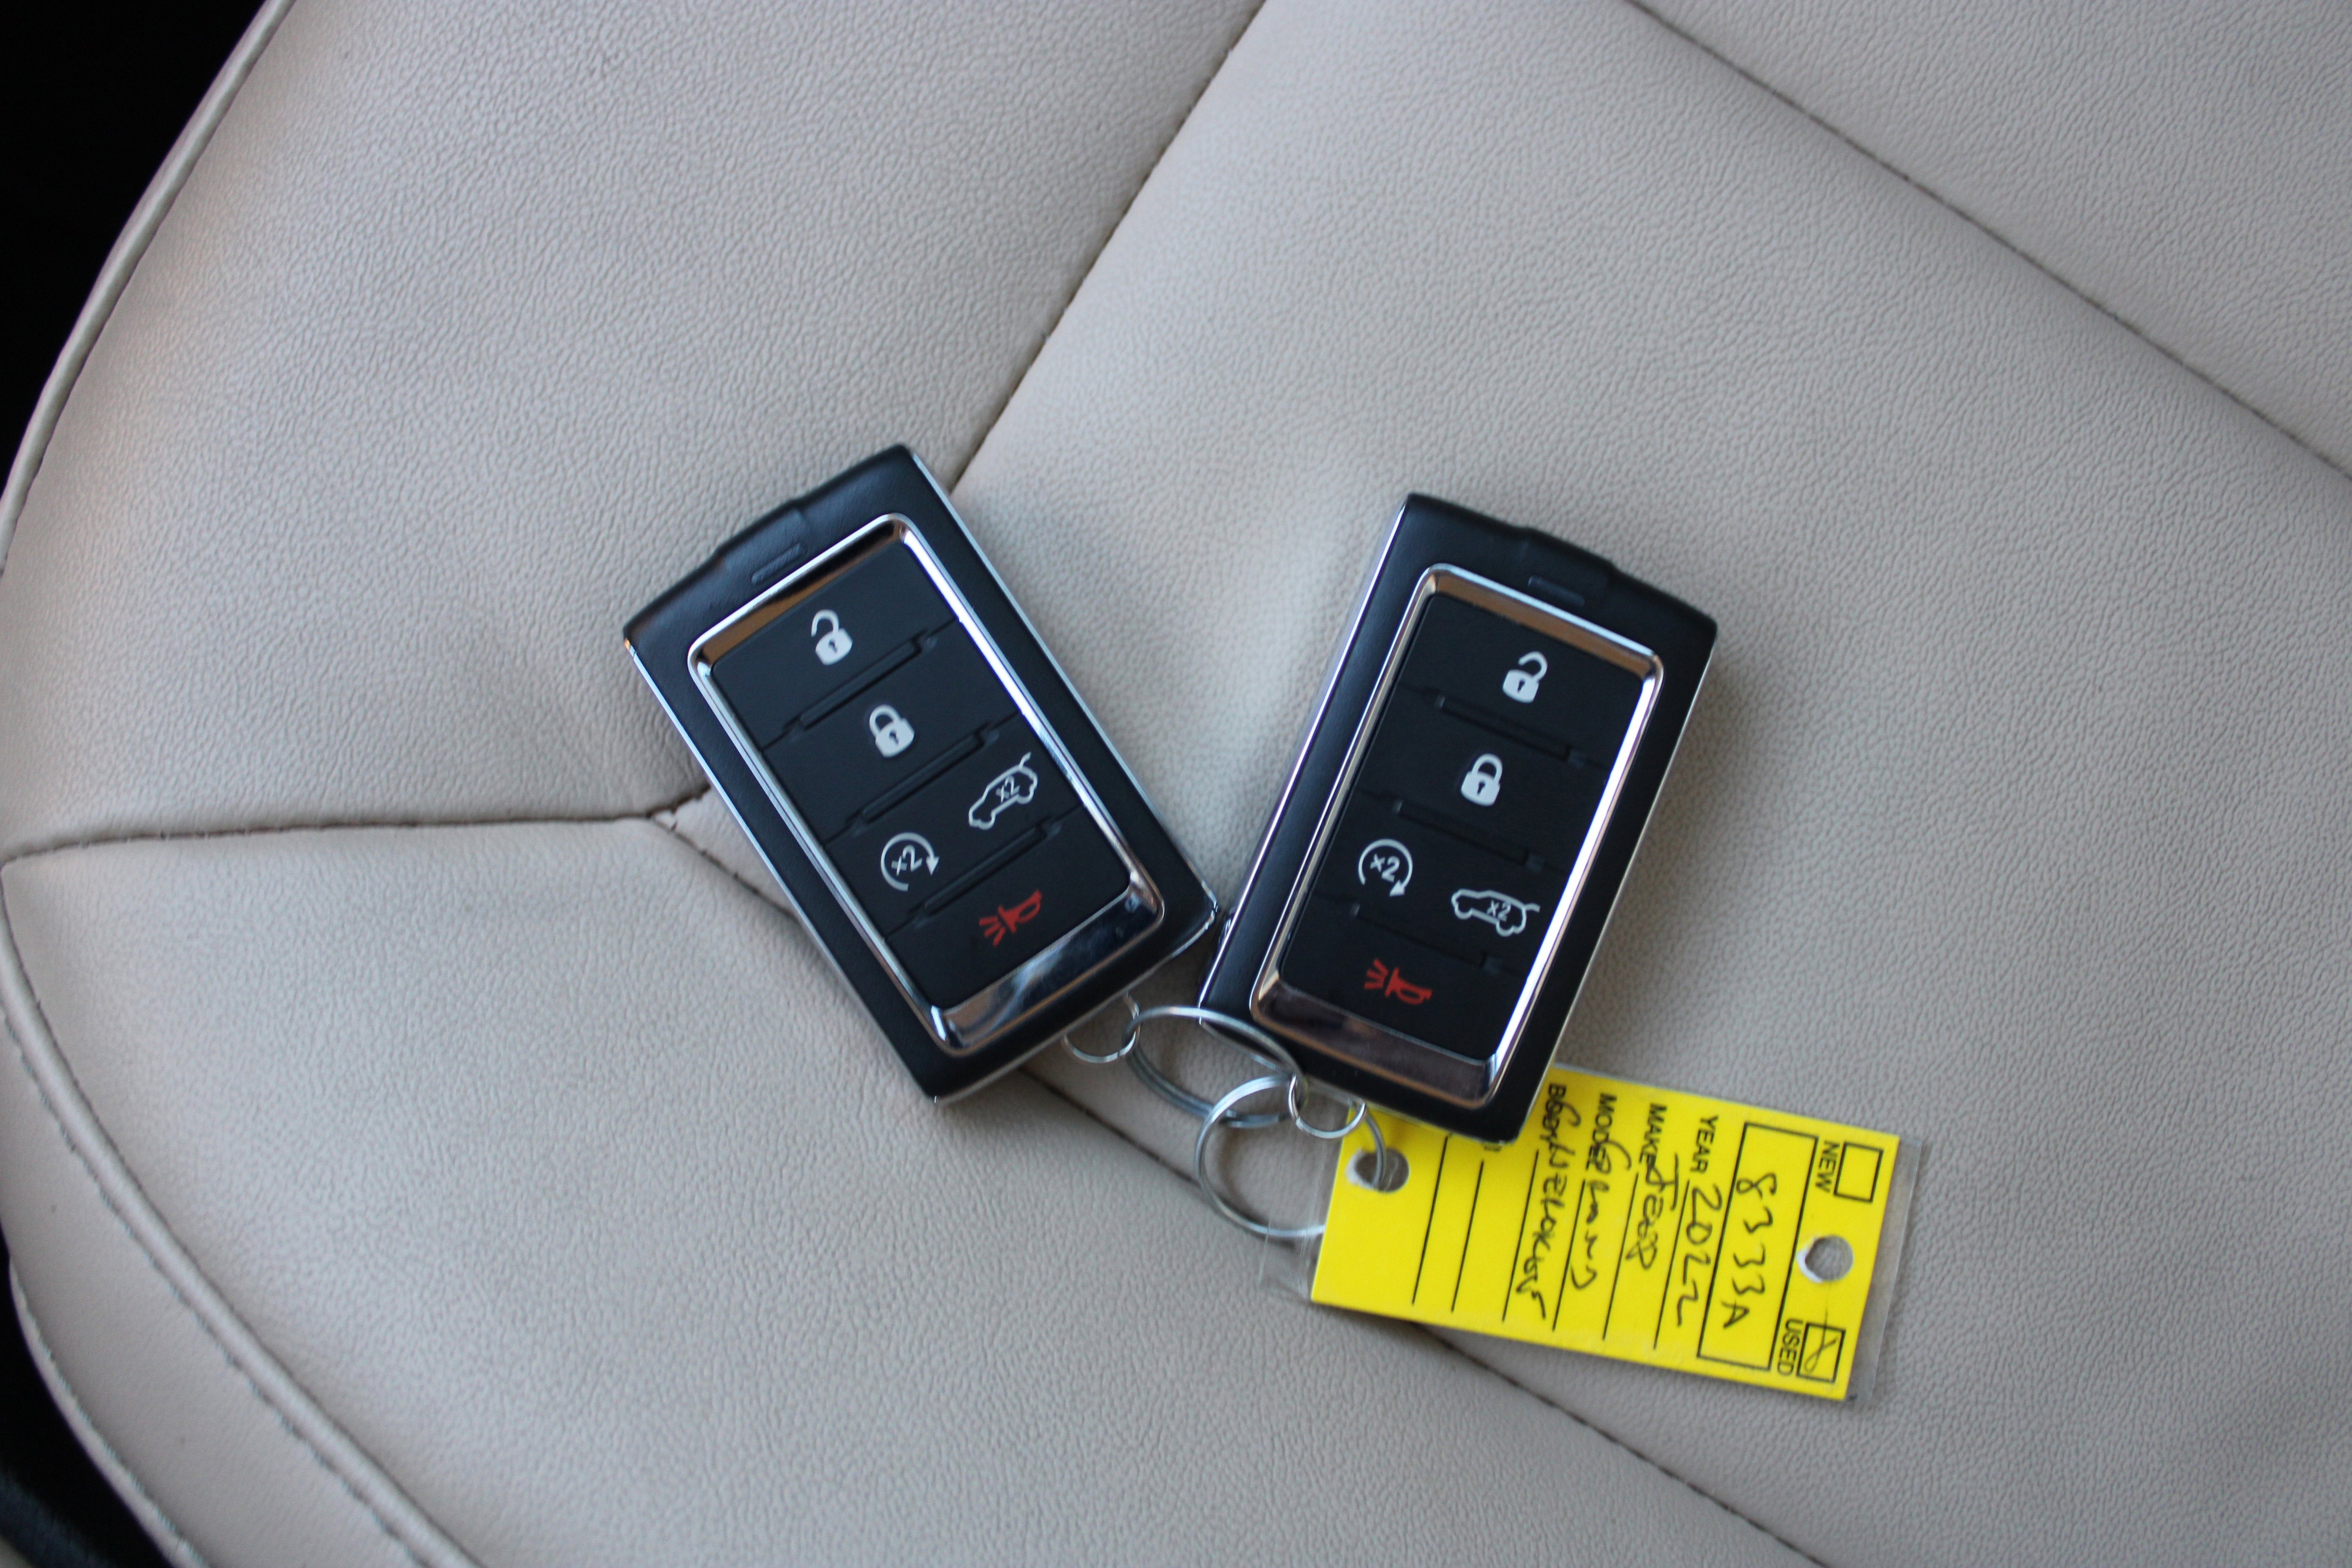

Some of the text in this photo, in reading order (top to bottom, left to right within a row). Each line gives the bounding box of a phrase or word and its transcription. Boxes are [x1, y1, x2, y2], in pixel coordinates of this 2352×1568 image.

[1586, 1092, 1617, 1170] MODEL
[1639, 1102, 1668, 1165] MAKE
[1691, 1115, 1719, 1174] YEAR
[1815, 1140, 1840, 1194] NEW
[1777, 1318, 1804, 1376] USED
